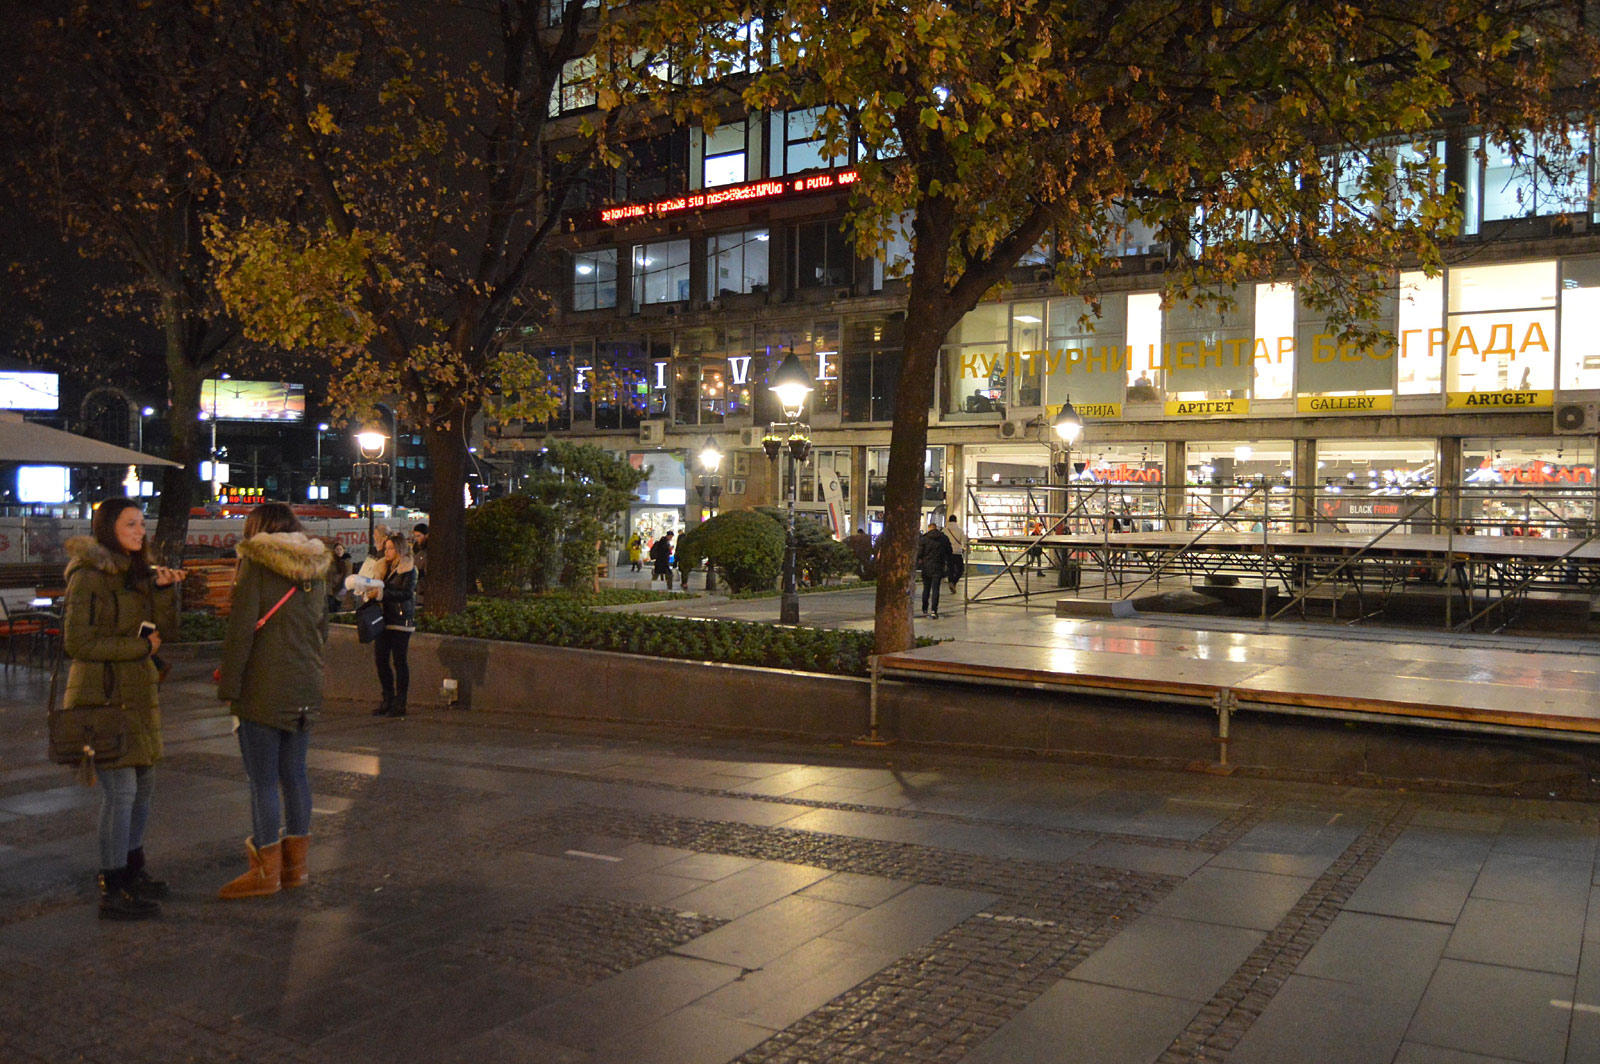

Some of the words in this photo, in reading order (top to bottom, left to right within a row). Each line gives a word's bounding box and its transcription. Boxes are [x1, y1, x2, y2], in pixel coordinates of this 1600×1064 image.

[960, 345, 1132, 379] КУЛТУРНИ
[1148, 335, 1297, 378] ЦЕНТАР
[1177, 401, 1234, 414] АРТГЕТ
[1310, 397, 1375, 410] GALLERY
[1466, 392, 1538, 406] ARTGET
[1349, 505, 1372, 514] BLACK
[1373, 505, 1398, 514] FRIDAY
